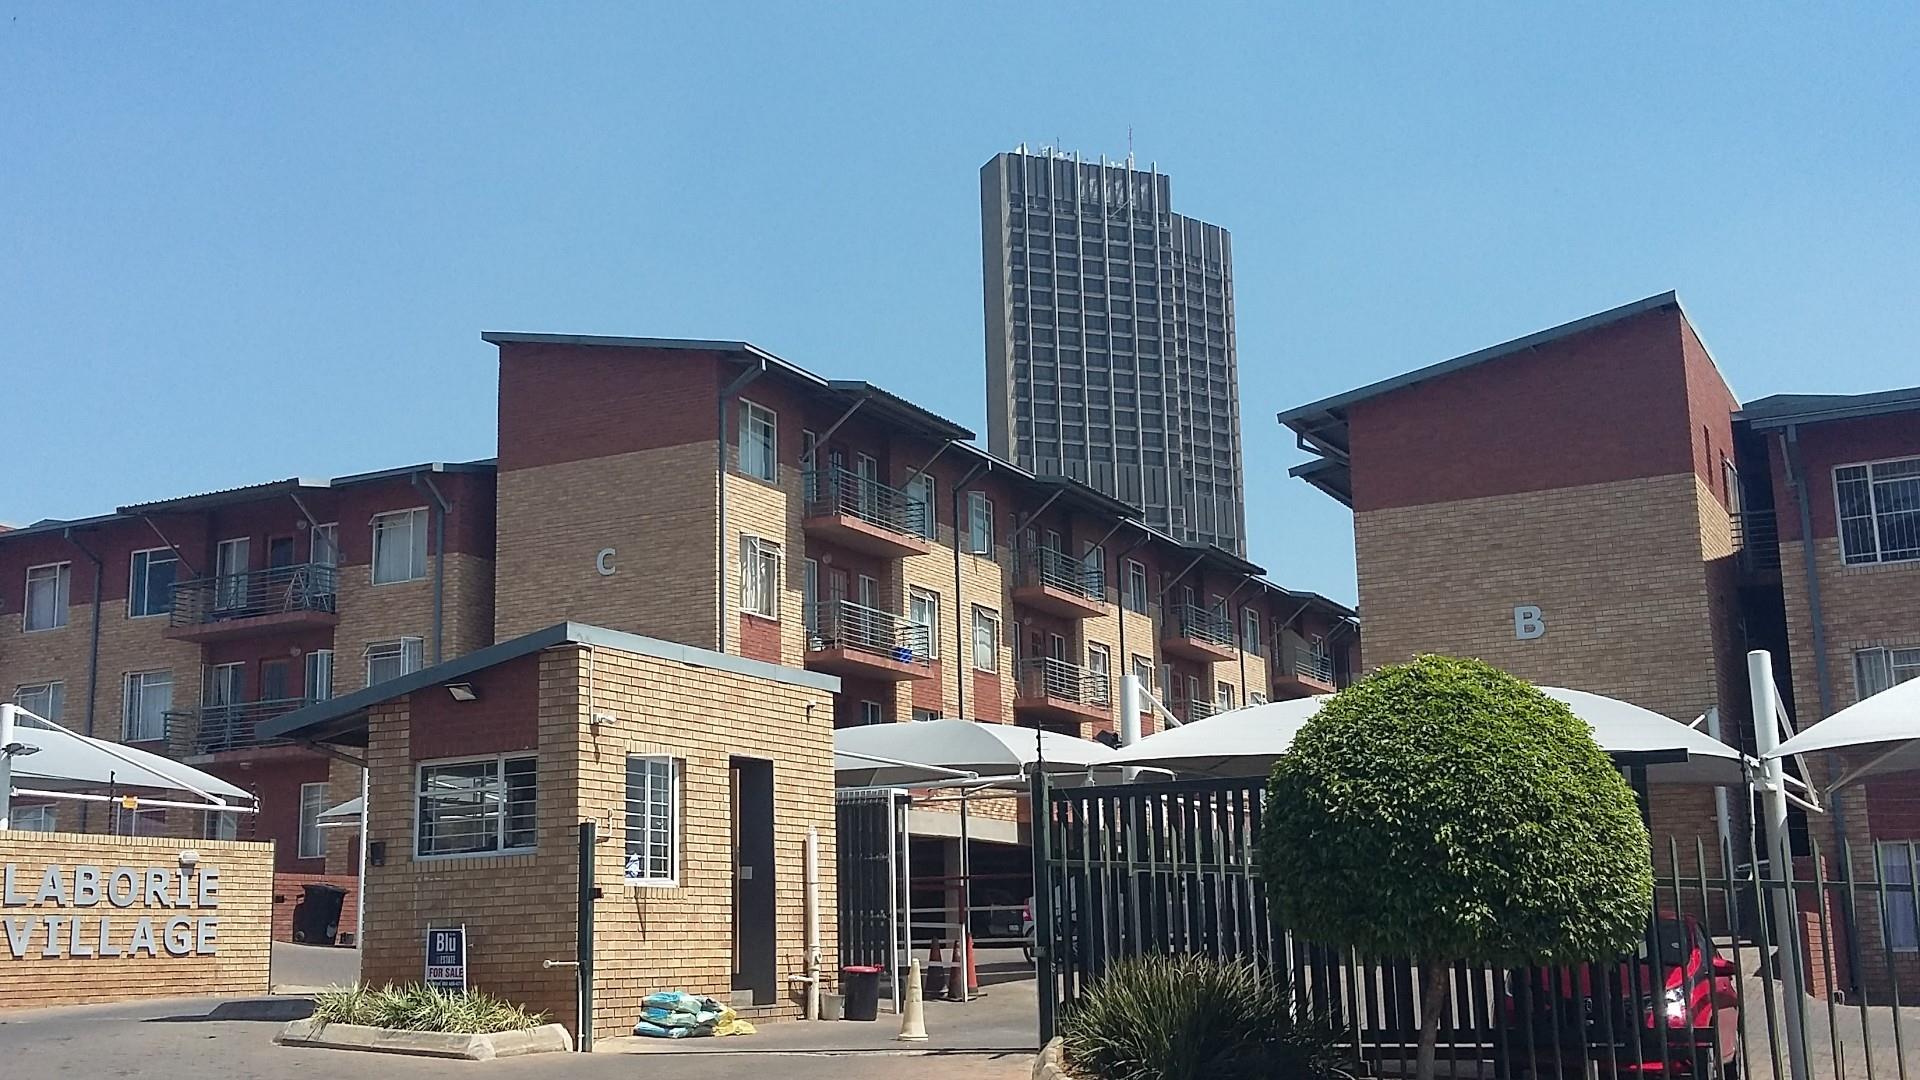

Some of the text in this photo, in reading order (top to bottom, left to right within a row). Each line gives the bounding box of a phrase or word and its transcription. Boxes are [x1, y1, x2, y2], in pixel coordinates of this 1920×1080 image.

[596, 548, 616, 576] C
[1513, 605, 1545, 640] B
[2, 864, 219, 907] LABORIE
[4, 914, 219, 957] VILLAGE
[429, 967, 463, 978] FOR SALE
